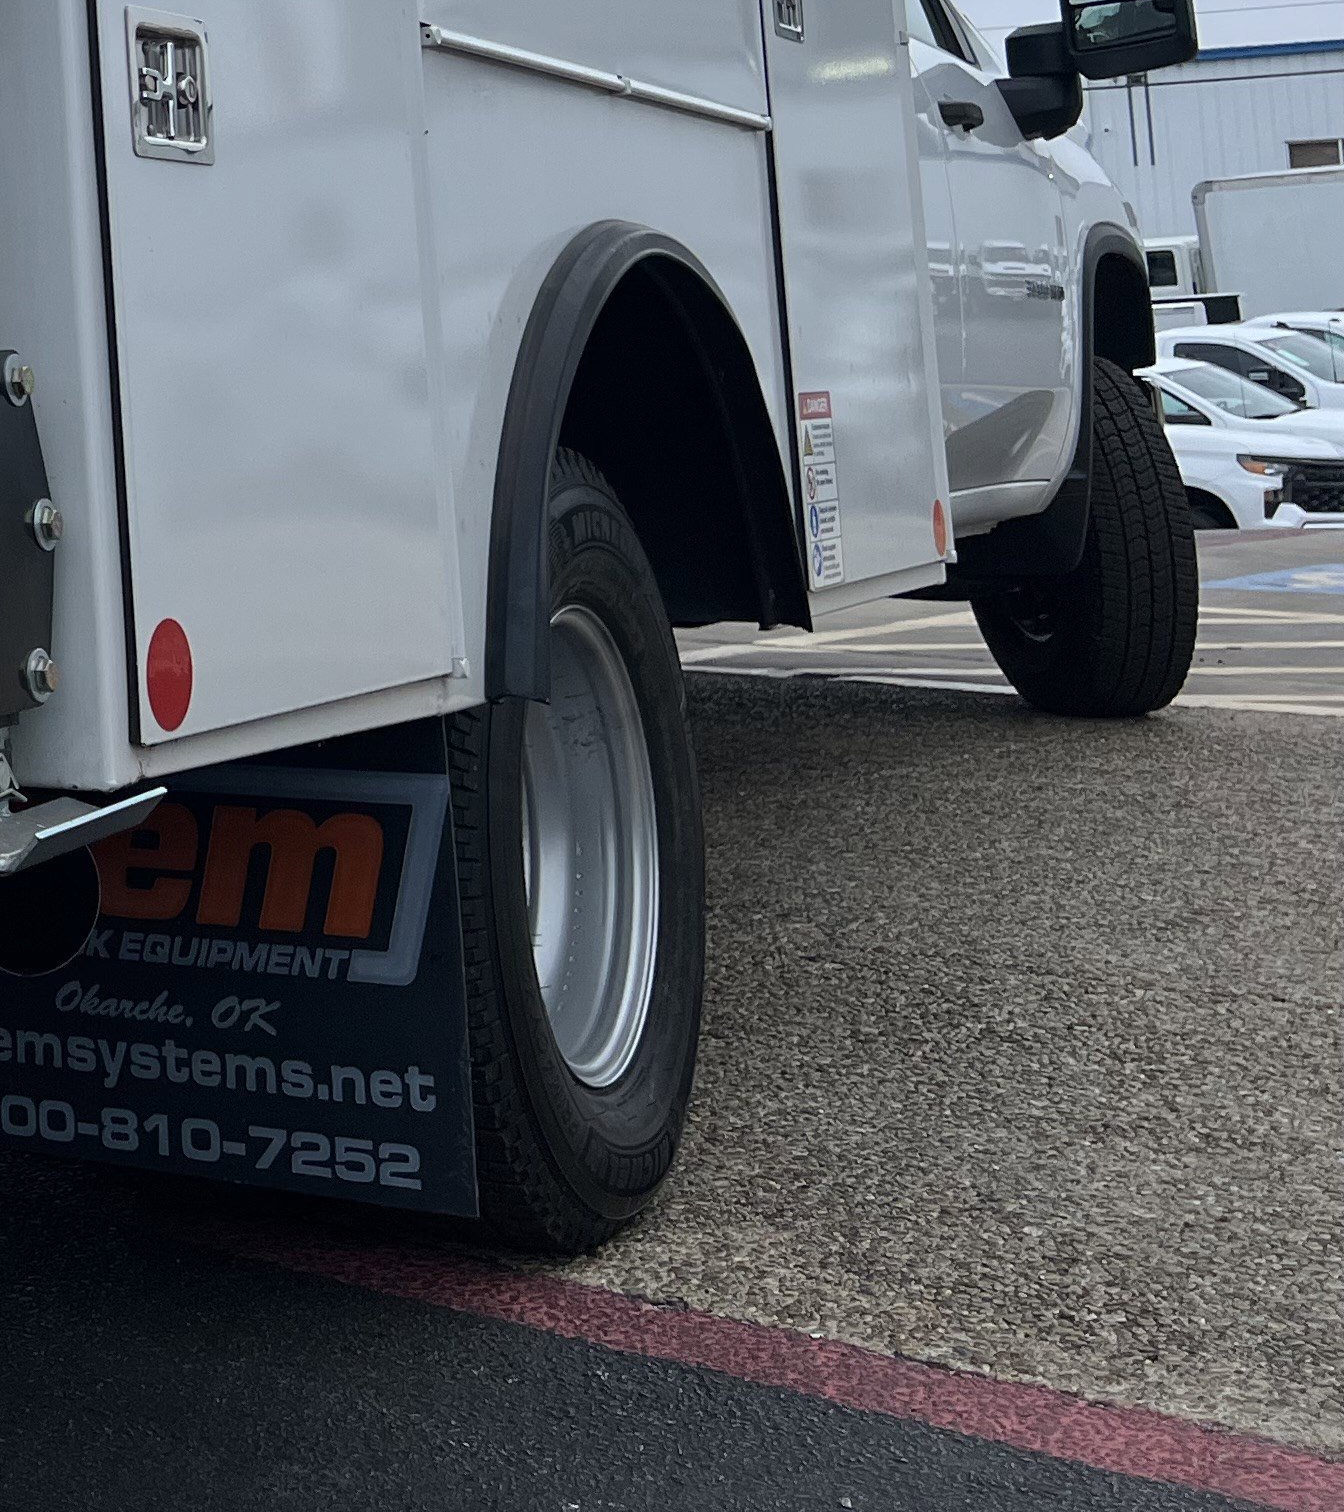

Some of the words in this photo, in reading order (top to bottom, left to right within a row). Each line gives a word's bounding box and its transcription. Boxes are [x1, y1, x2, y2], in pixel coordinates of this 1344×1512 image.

[92, 802, 384, 939] em
[118, 931, 352, 980] EQUIPMENT
[55, 979, 194, 1029] Okarche,
[211, 995, 282, 1037] OK
